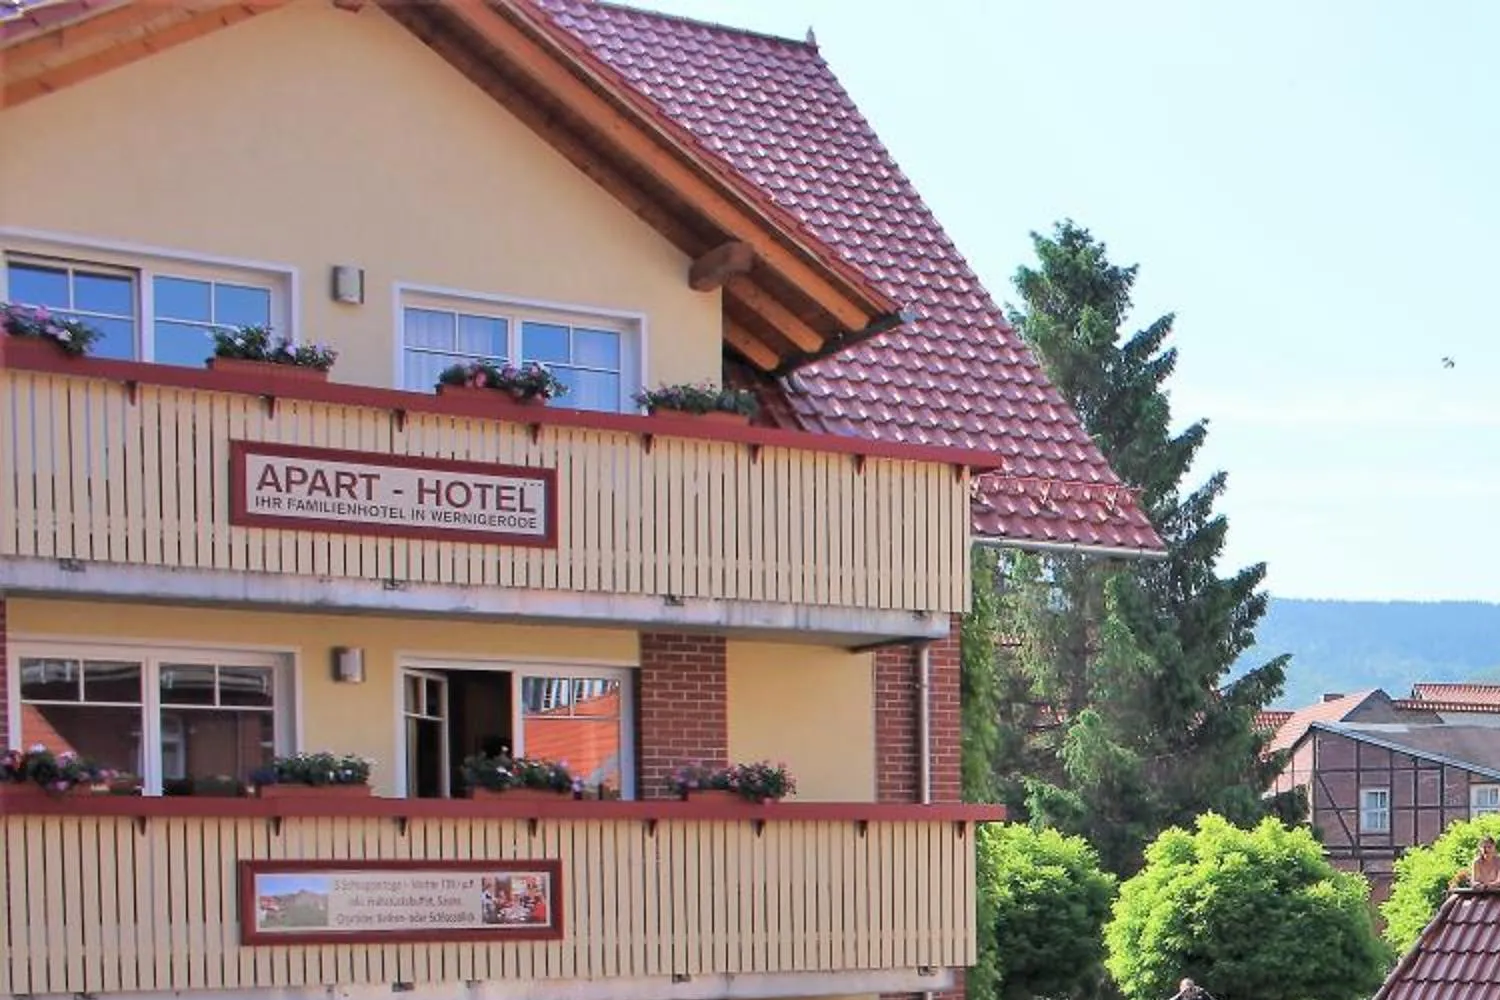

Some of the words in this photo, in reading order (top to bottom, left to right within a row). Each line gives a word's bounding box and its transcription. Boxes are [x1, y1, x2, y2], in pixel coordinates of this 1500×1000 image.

[256, 463, 381, 501] APART
[417, 476, 537, 514] HOTEL
[255, 496, 282, 509] IHR
[287, 498, 405, 520] FAMILIENHOTEL
[411, 508, 426, 521] IN
[430, 511, 538, 530] WERNIGERODE
